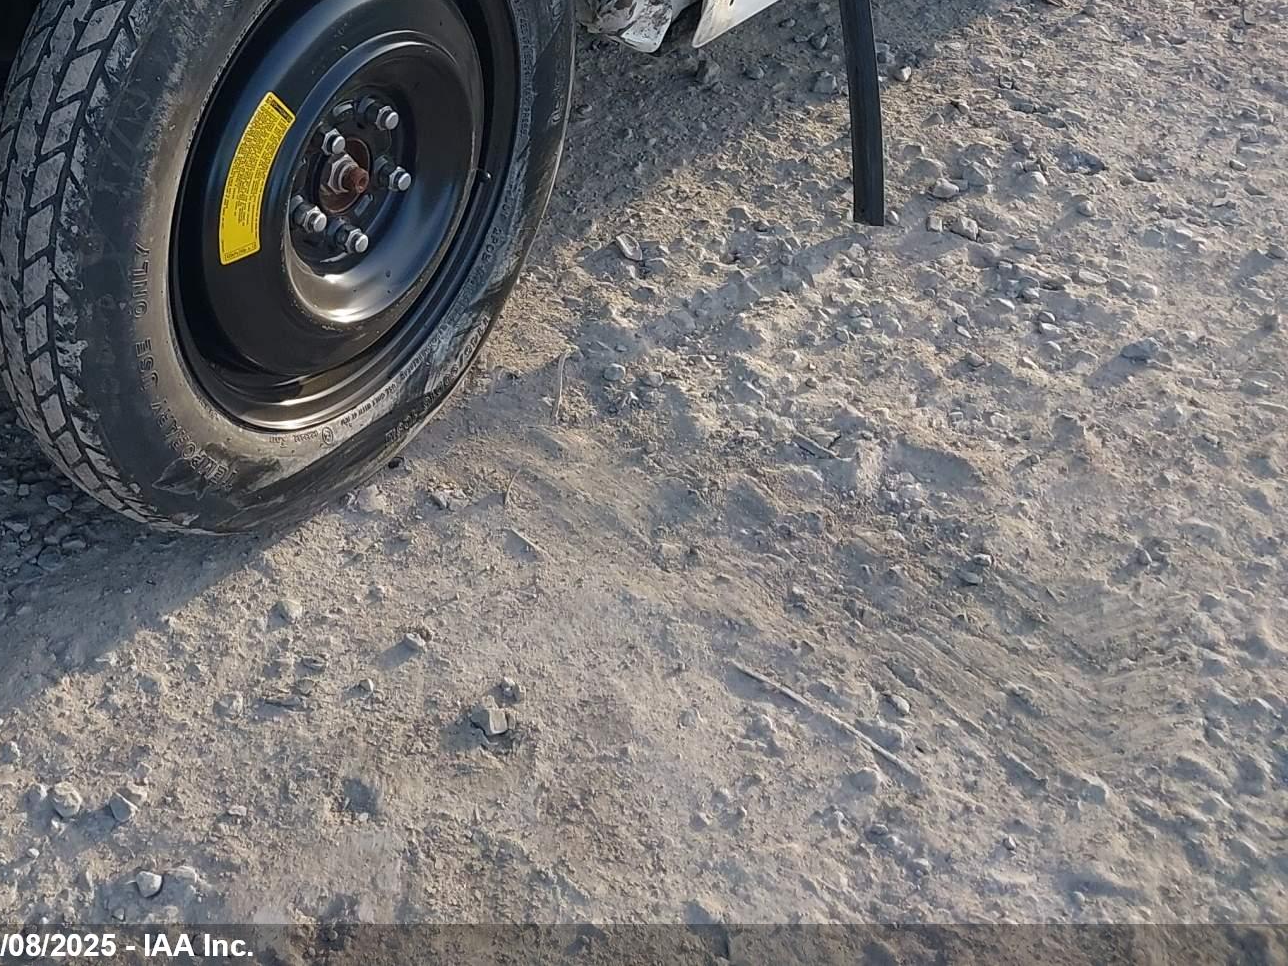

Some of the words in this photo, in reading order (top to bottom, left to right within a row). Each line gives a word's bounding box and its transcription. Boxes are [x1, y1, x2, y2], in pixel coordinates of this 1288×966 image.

[130, 242, 151, 319] ONLY
[135, 337, 160, 392] USE
[151, 398, 240, 491] TEMPORARY
